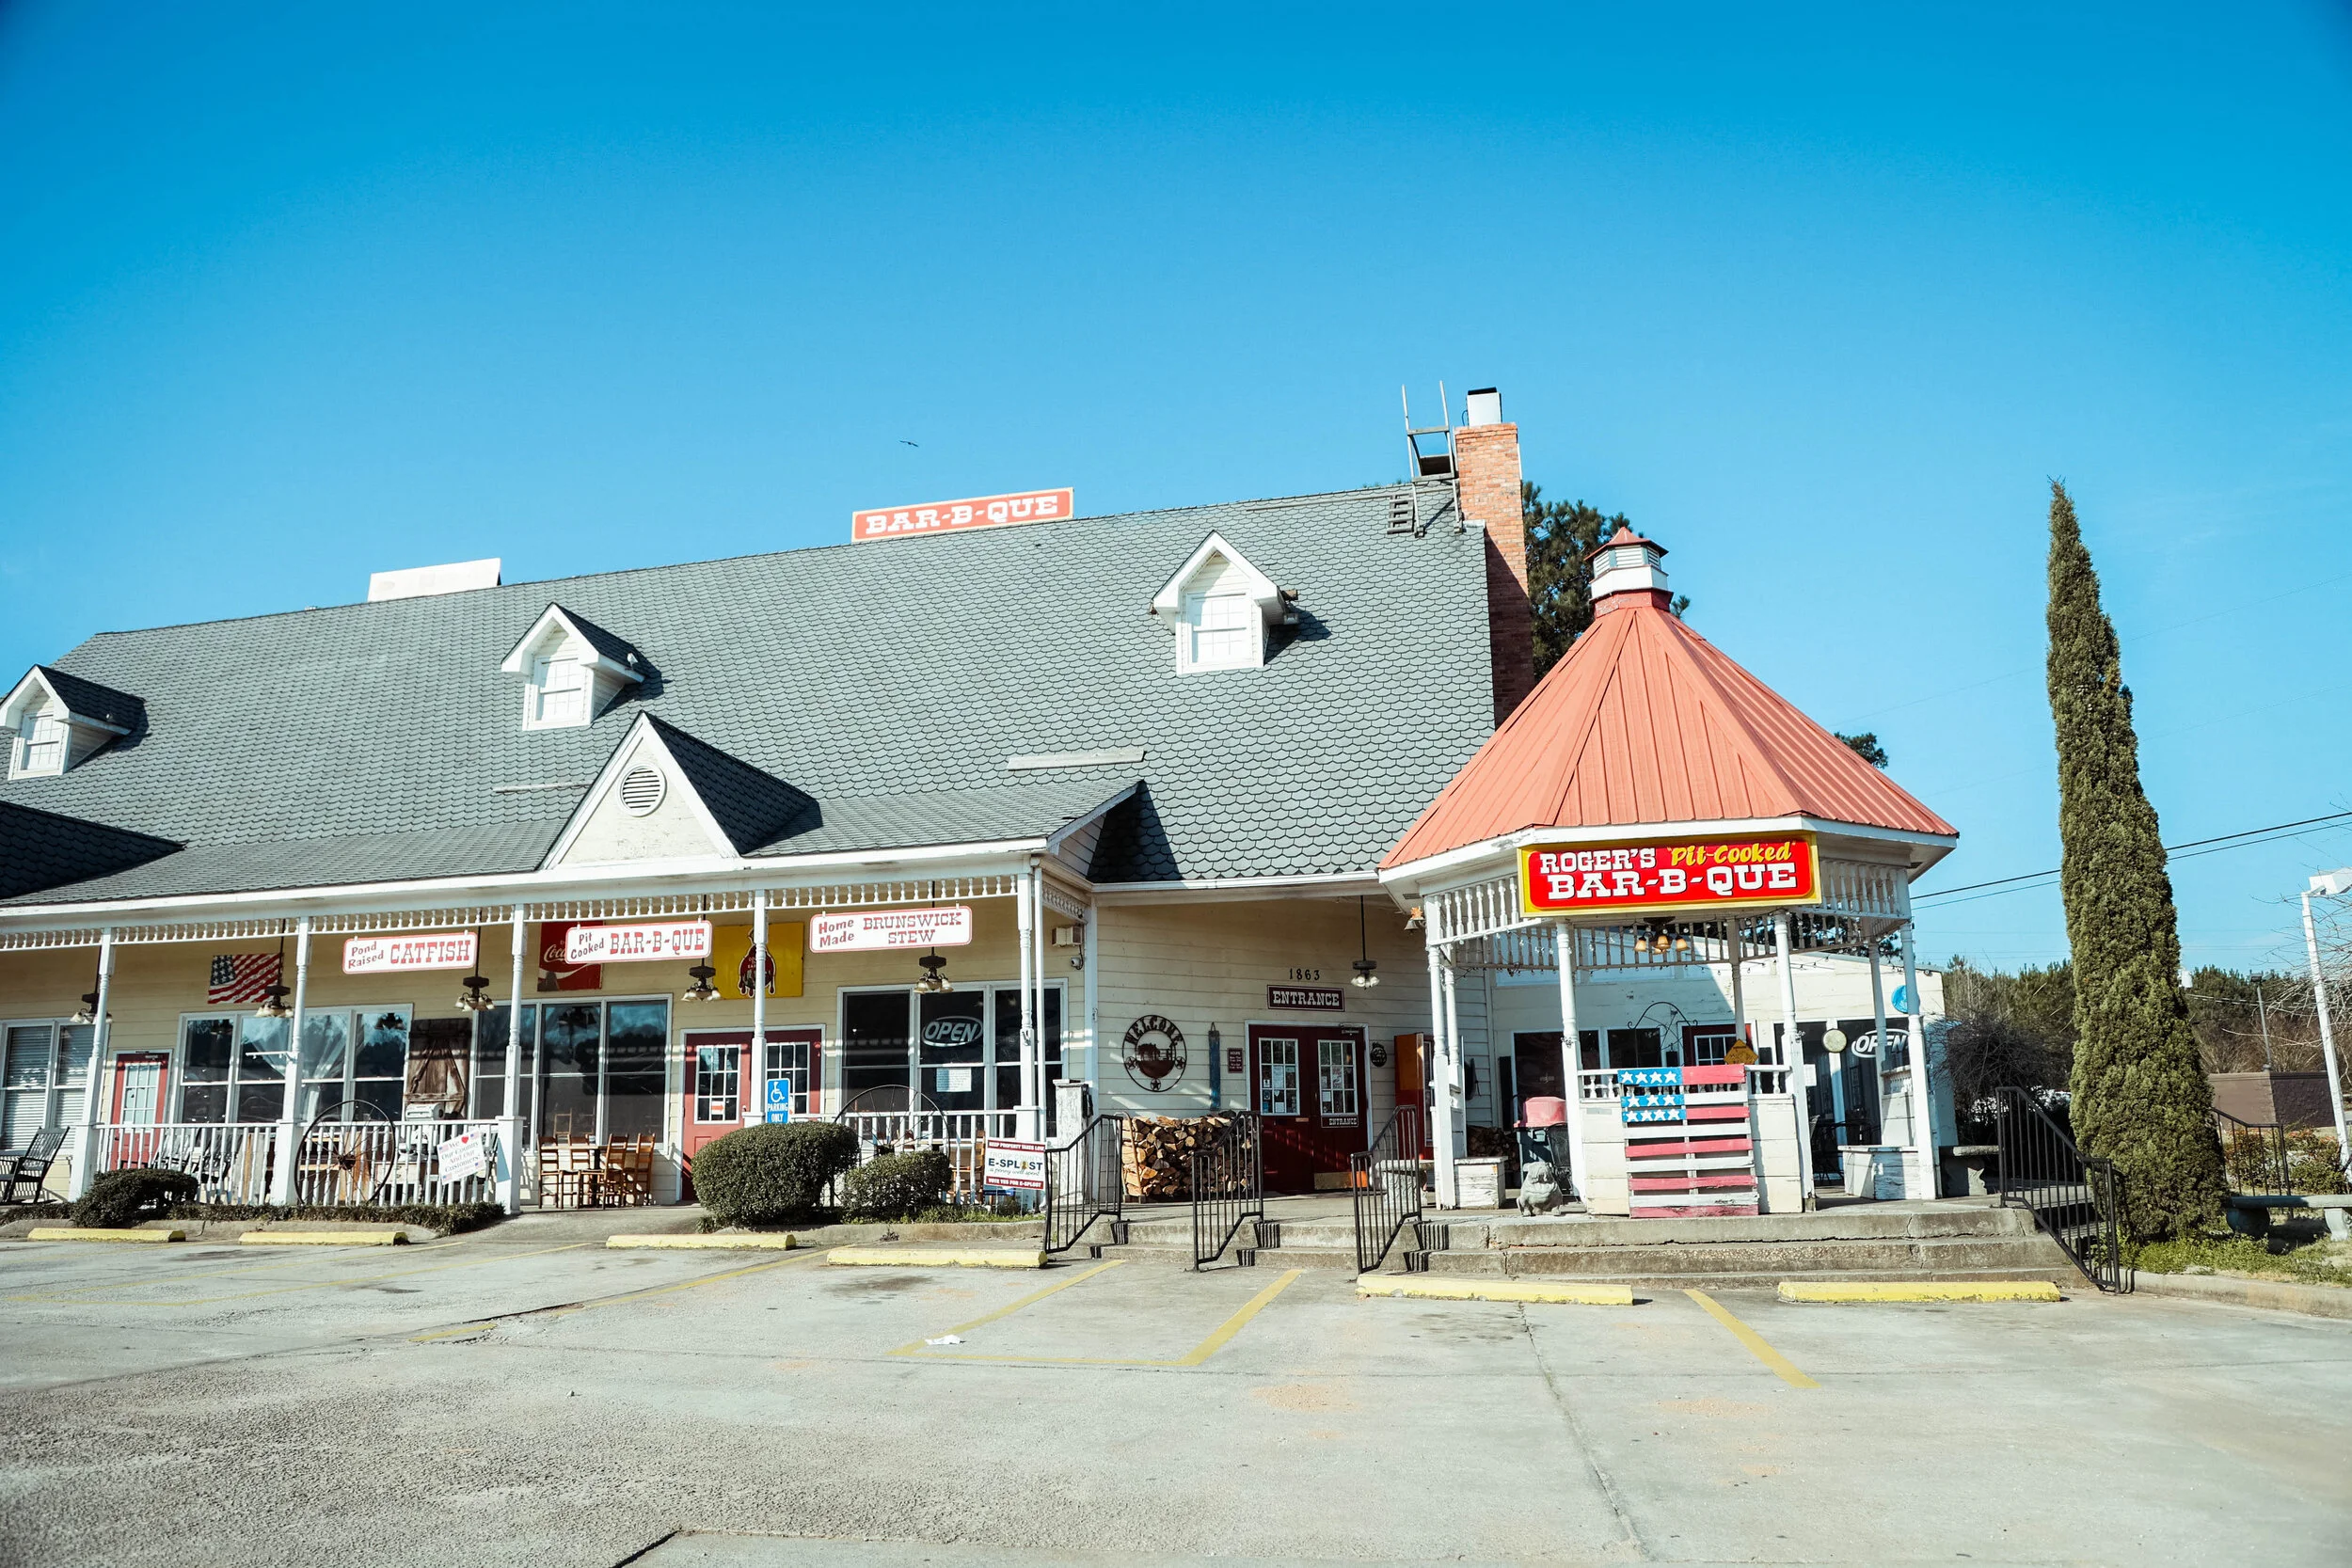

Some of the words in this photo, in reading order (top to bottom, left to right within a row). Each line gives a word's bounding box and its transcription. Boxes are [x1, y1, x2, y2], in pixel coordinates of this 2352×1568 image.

[866, 495, 1057, 534] BAR-B-QUE
[1539, 847, 1656, 875] ROGER'S
[1547, 862, 1797, 900] BAR-B-QUE
[818, 919, 854, 934] Home
[863, 911, 962, 930] BRUNSWICK
[579, 932, 593, 945] Pit
[610, 928, 705, 956] BAR-B-QUE
[819, 931, 855, 947] Made
[888, 929, 935, 944] STEW
[351, 941, 377, 957] Pond
[390, 940, 471, 964] CATFISH
[570, 938, 604, 959] Cooked
[348, 950, 384, 969] Raised
[1289, 968, 1320, 980] 1863
[1273, 990, 1340, 1006] ENTRANCE
[925, 1022, 978, 1041] OPEN
[1125, 1016, 1184, 1048] WELCOME
[767, 1102, 788, 1112] PARKING
[771, 1114, 785, 1123] ONLY
[1328, 1117, 1358, 1126] ENTRANCE
[441, 1151, 453, 1160] Our
[454, 1142, 479, 1155] Country
[451, 1155, 463, 1164] And
[463, 1149, 475, 1158] Our
